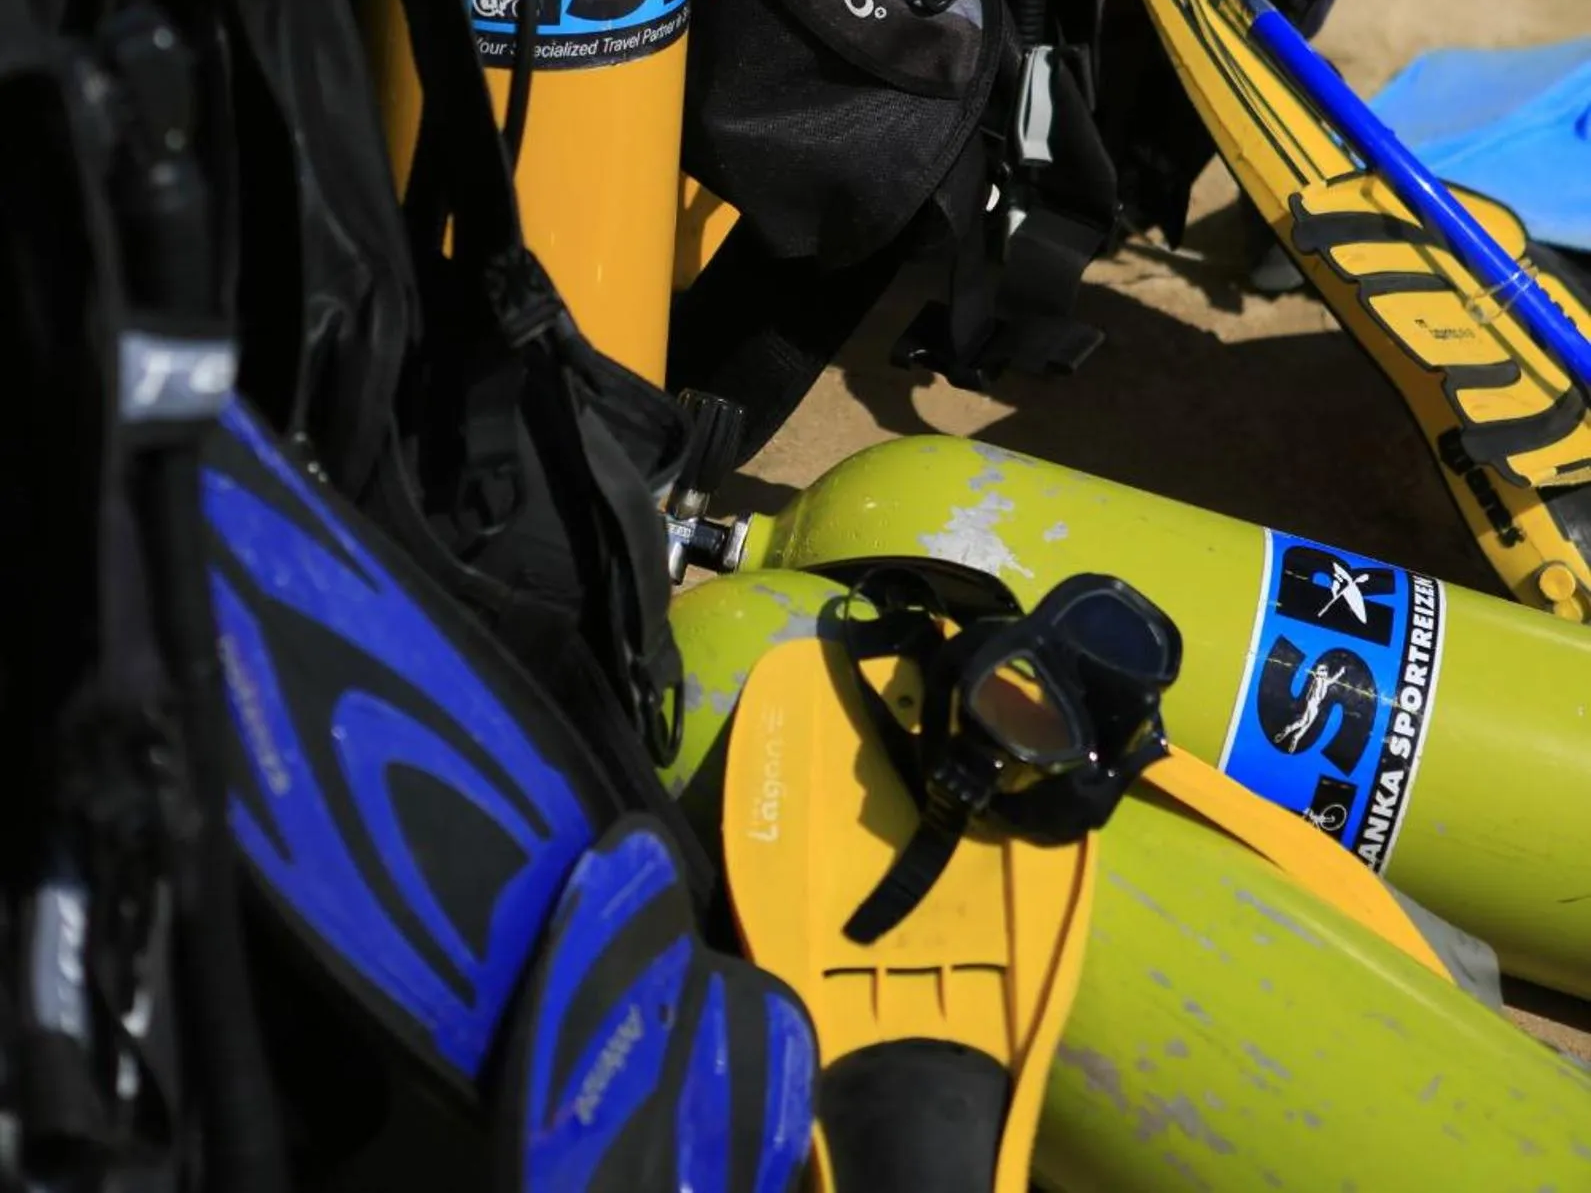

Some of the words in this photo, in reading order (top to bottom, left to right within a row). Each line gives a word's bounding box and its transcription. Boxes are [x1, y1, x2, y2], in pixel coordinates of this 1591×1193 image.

[511, 40, 598, 59] ecialized
[603, 29, 641, 55] Travel
[642, 19, 676, 46] Partner
[1357, 768, 1404, 869] ANKA
